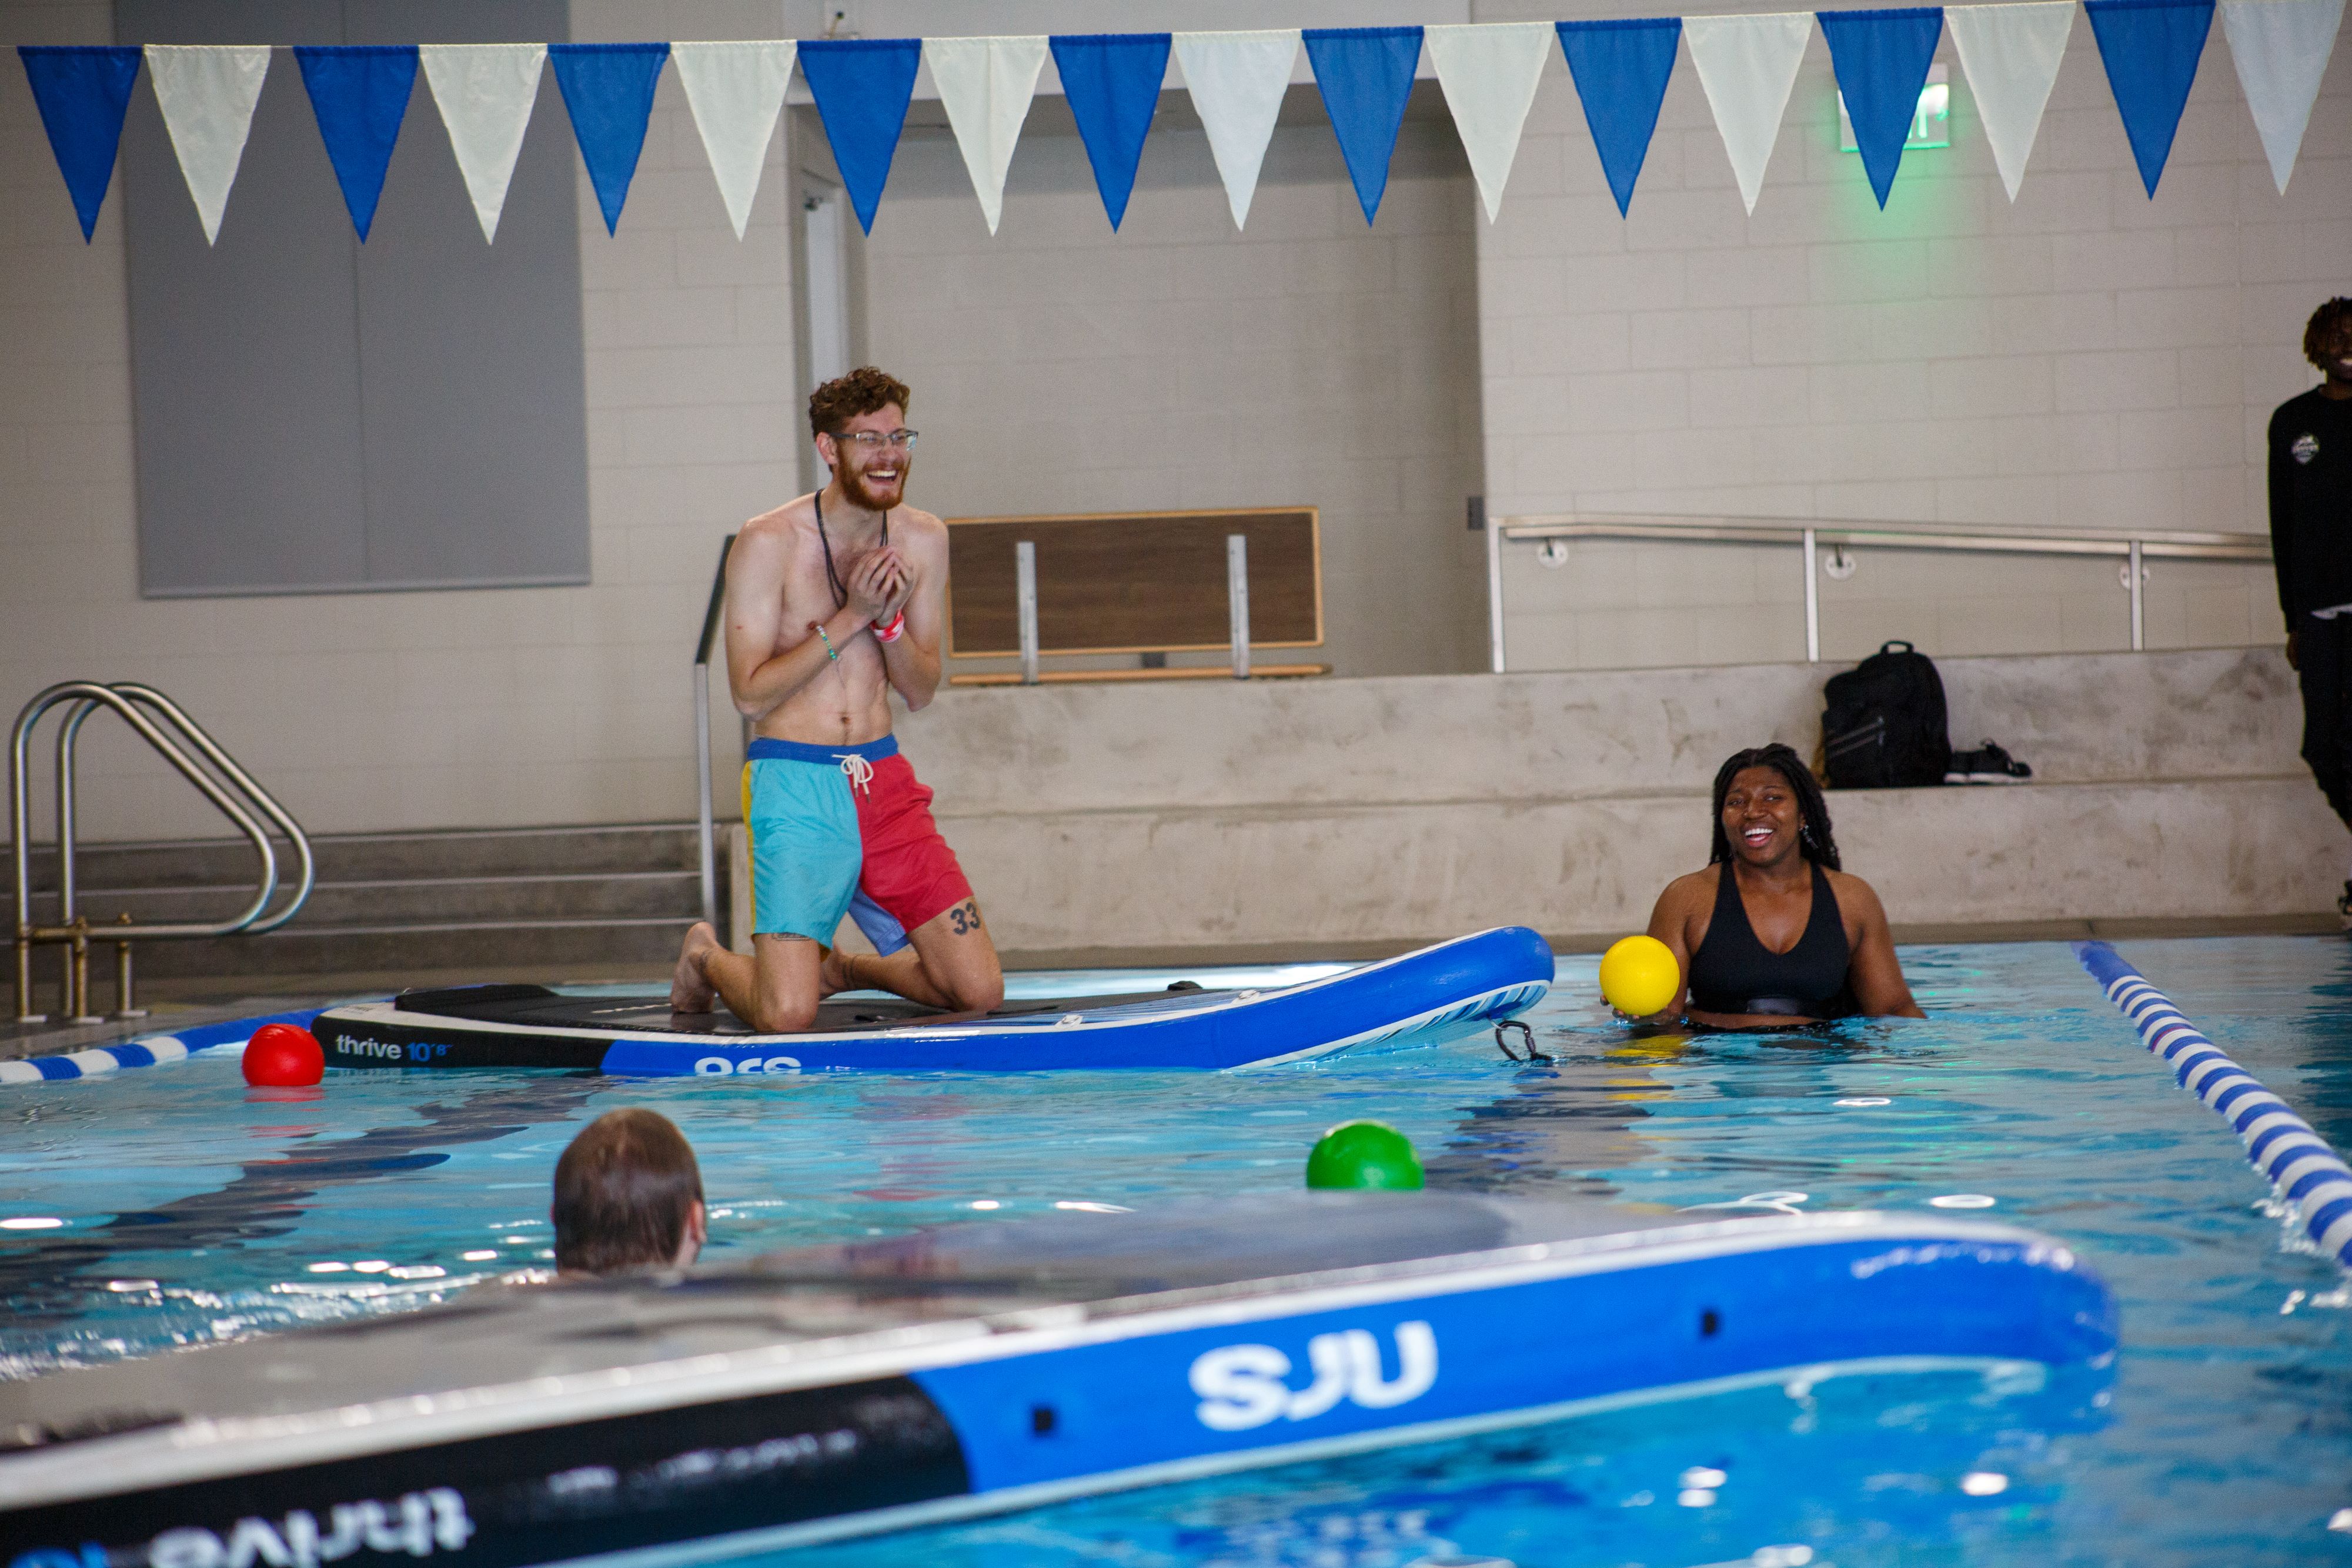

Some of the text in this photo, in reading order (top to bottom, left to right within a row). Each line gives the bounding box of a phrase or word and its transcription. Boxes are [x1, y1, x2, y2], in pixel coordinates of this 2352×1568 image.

[950, 902, 981, 935] 33
[336, 1034, 403, 1059] thrive
[1188, 1320, 1438, 1431] SJU
